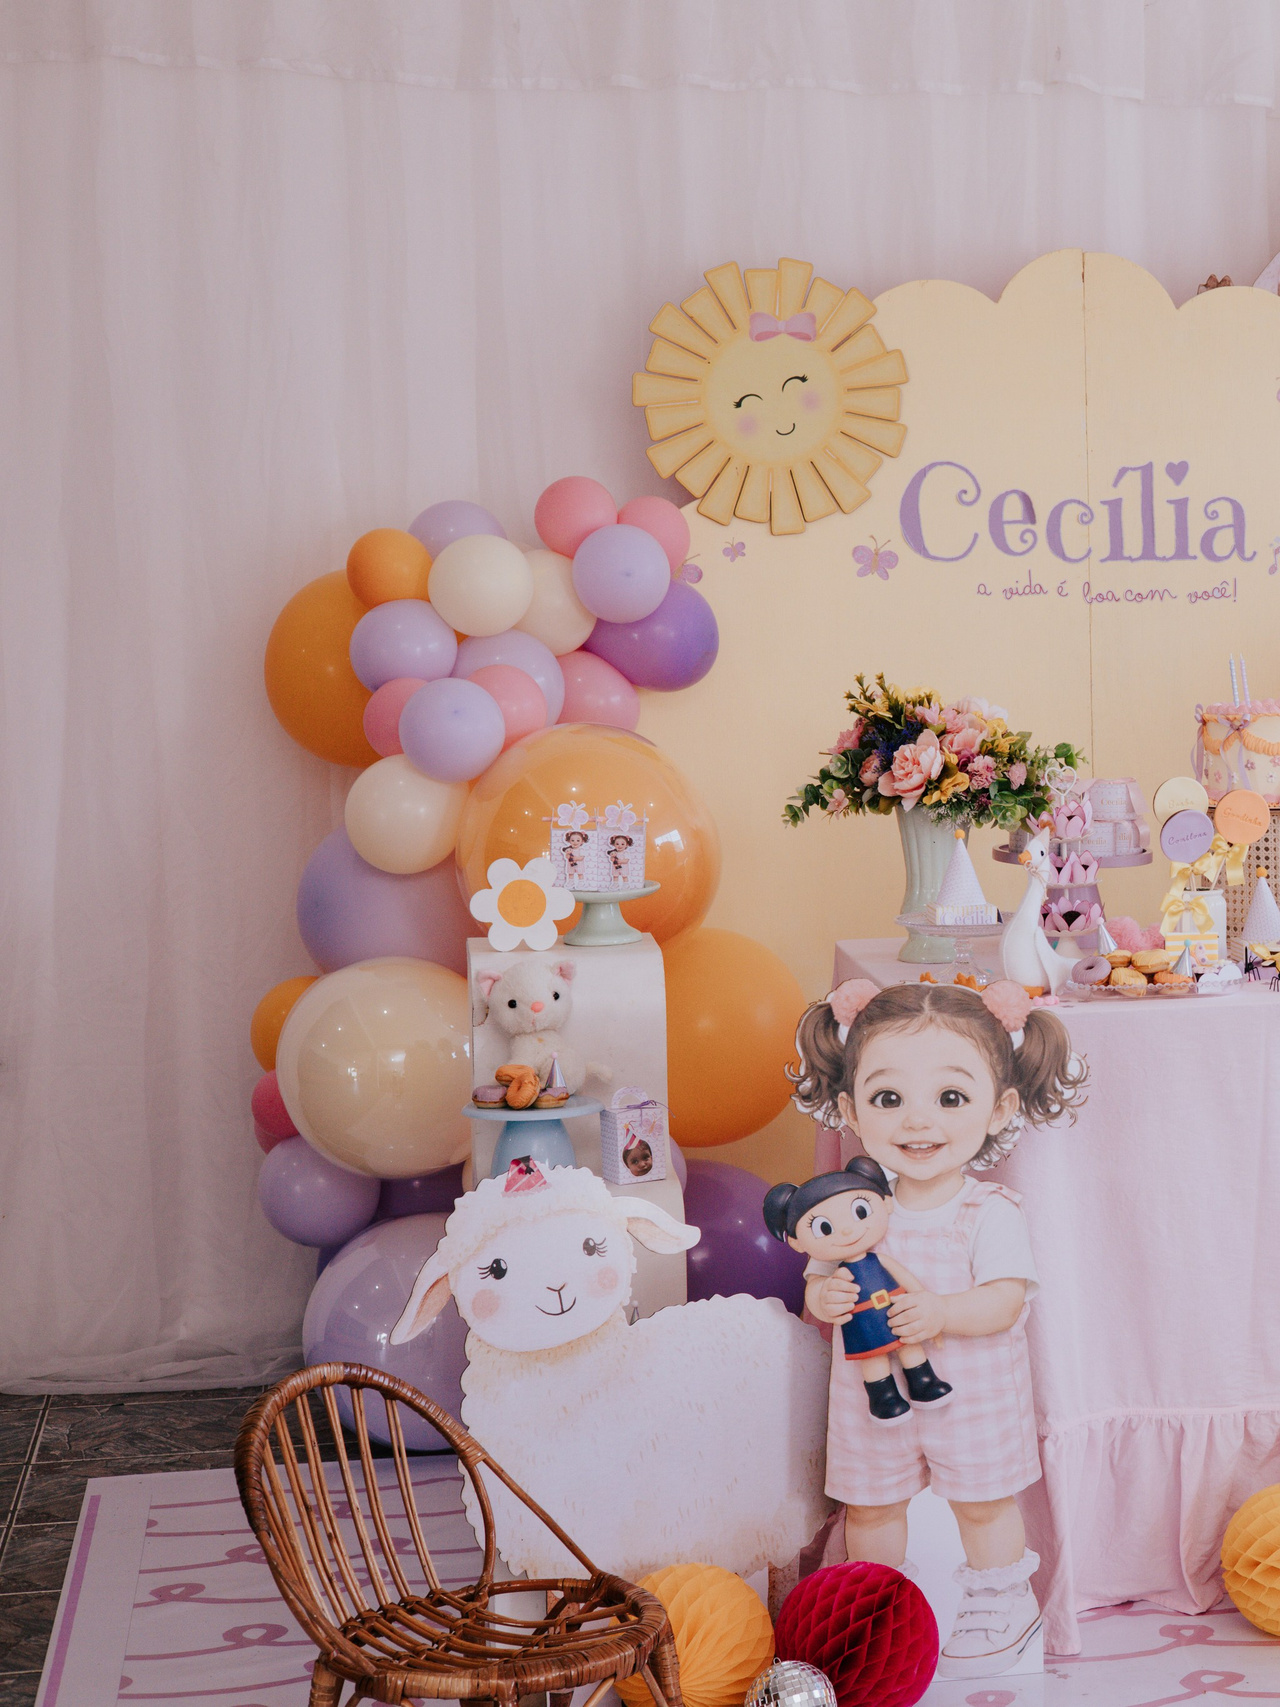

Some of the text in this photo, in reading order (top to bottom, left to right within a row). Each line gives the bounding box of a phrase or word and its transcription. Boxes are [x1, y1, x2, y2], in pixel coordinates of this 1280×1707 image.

[898, 460, 1257, 563] Cecília
[977, 569, 1237, 604] a vida é boa com você!
